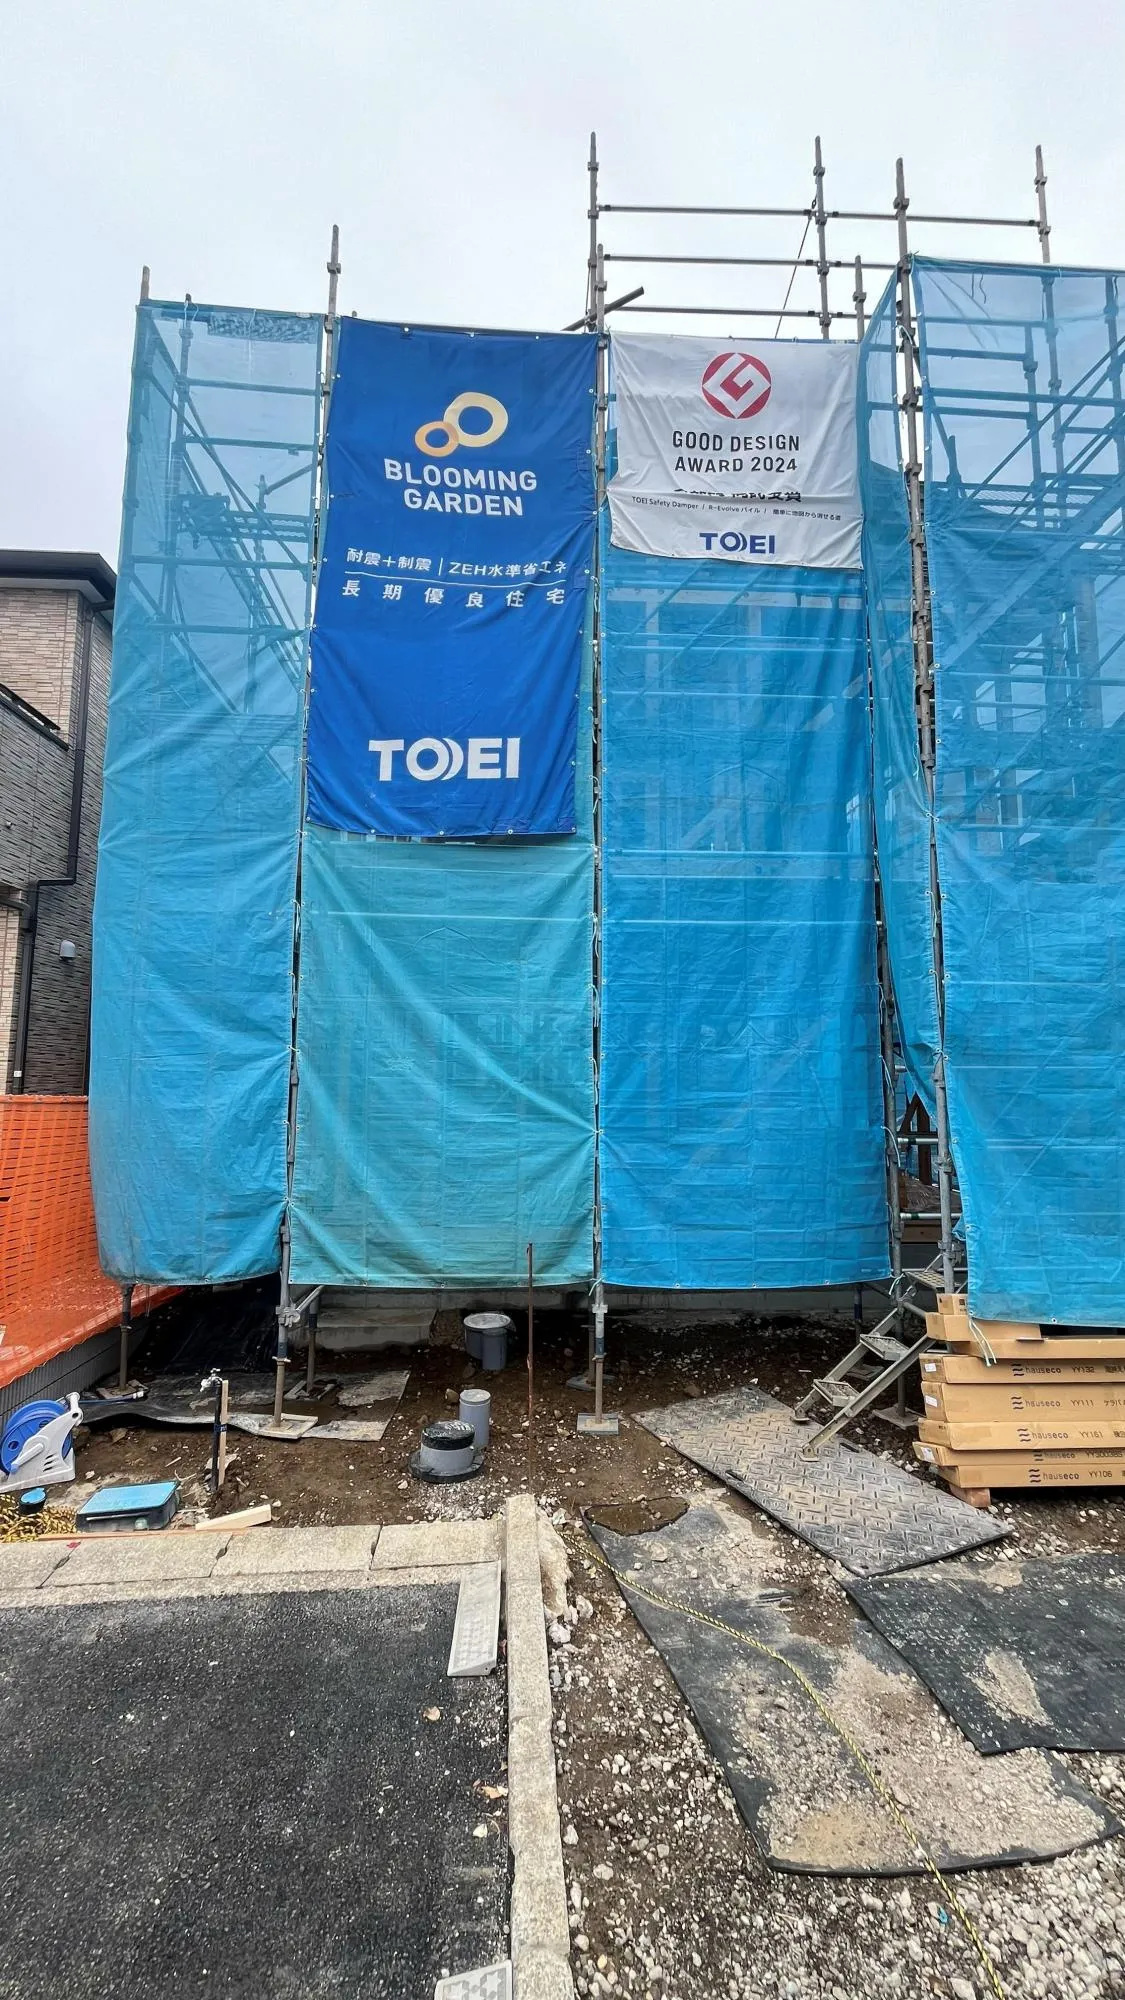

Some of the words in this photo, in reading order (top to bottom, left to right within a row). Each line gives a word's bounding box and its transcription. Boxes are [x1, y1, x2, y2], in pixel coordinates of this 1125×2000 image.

[672, 430, 723, 452] GOOD
[730, 434, 800, 453] DESIGN
[675, 456, 744, 473] AWARD
[750, 456, 798, 473] 2024
[383, 458, 538, 492] BLOOMING
[403, 488, 524, 516] GARDEN
[632, 496, 648, 504] TOEI
[649, 499, 671, 508] Safety
[672, 501, 699, 510] Damper
[699, 532, 776, 554] TOEI
[341, 579, 566, 608] 長期優良住宅
[368, 737, 521, 782] TOEI
[1025, 1366, 1062, 1374] hauseco
[1025, 1399, 1061, 1407] hauseco
[1032, 1431, 1069, 1440] hauseco
[1043, 1471, 1080, 1480] hauseco
